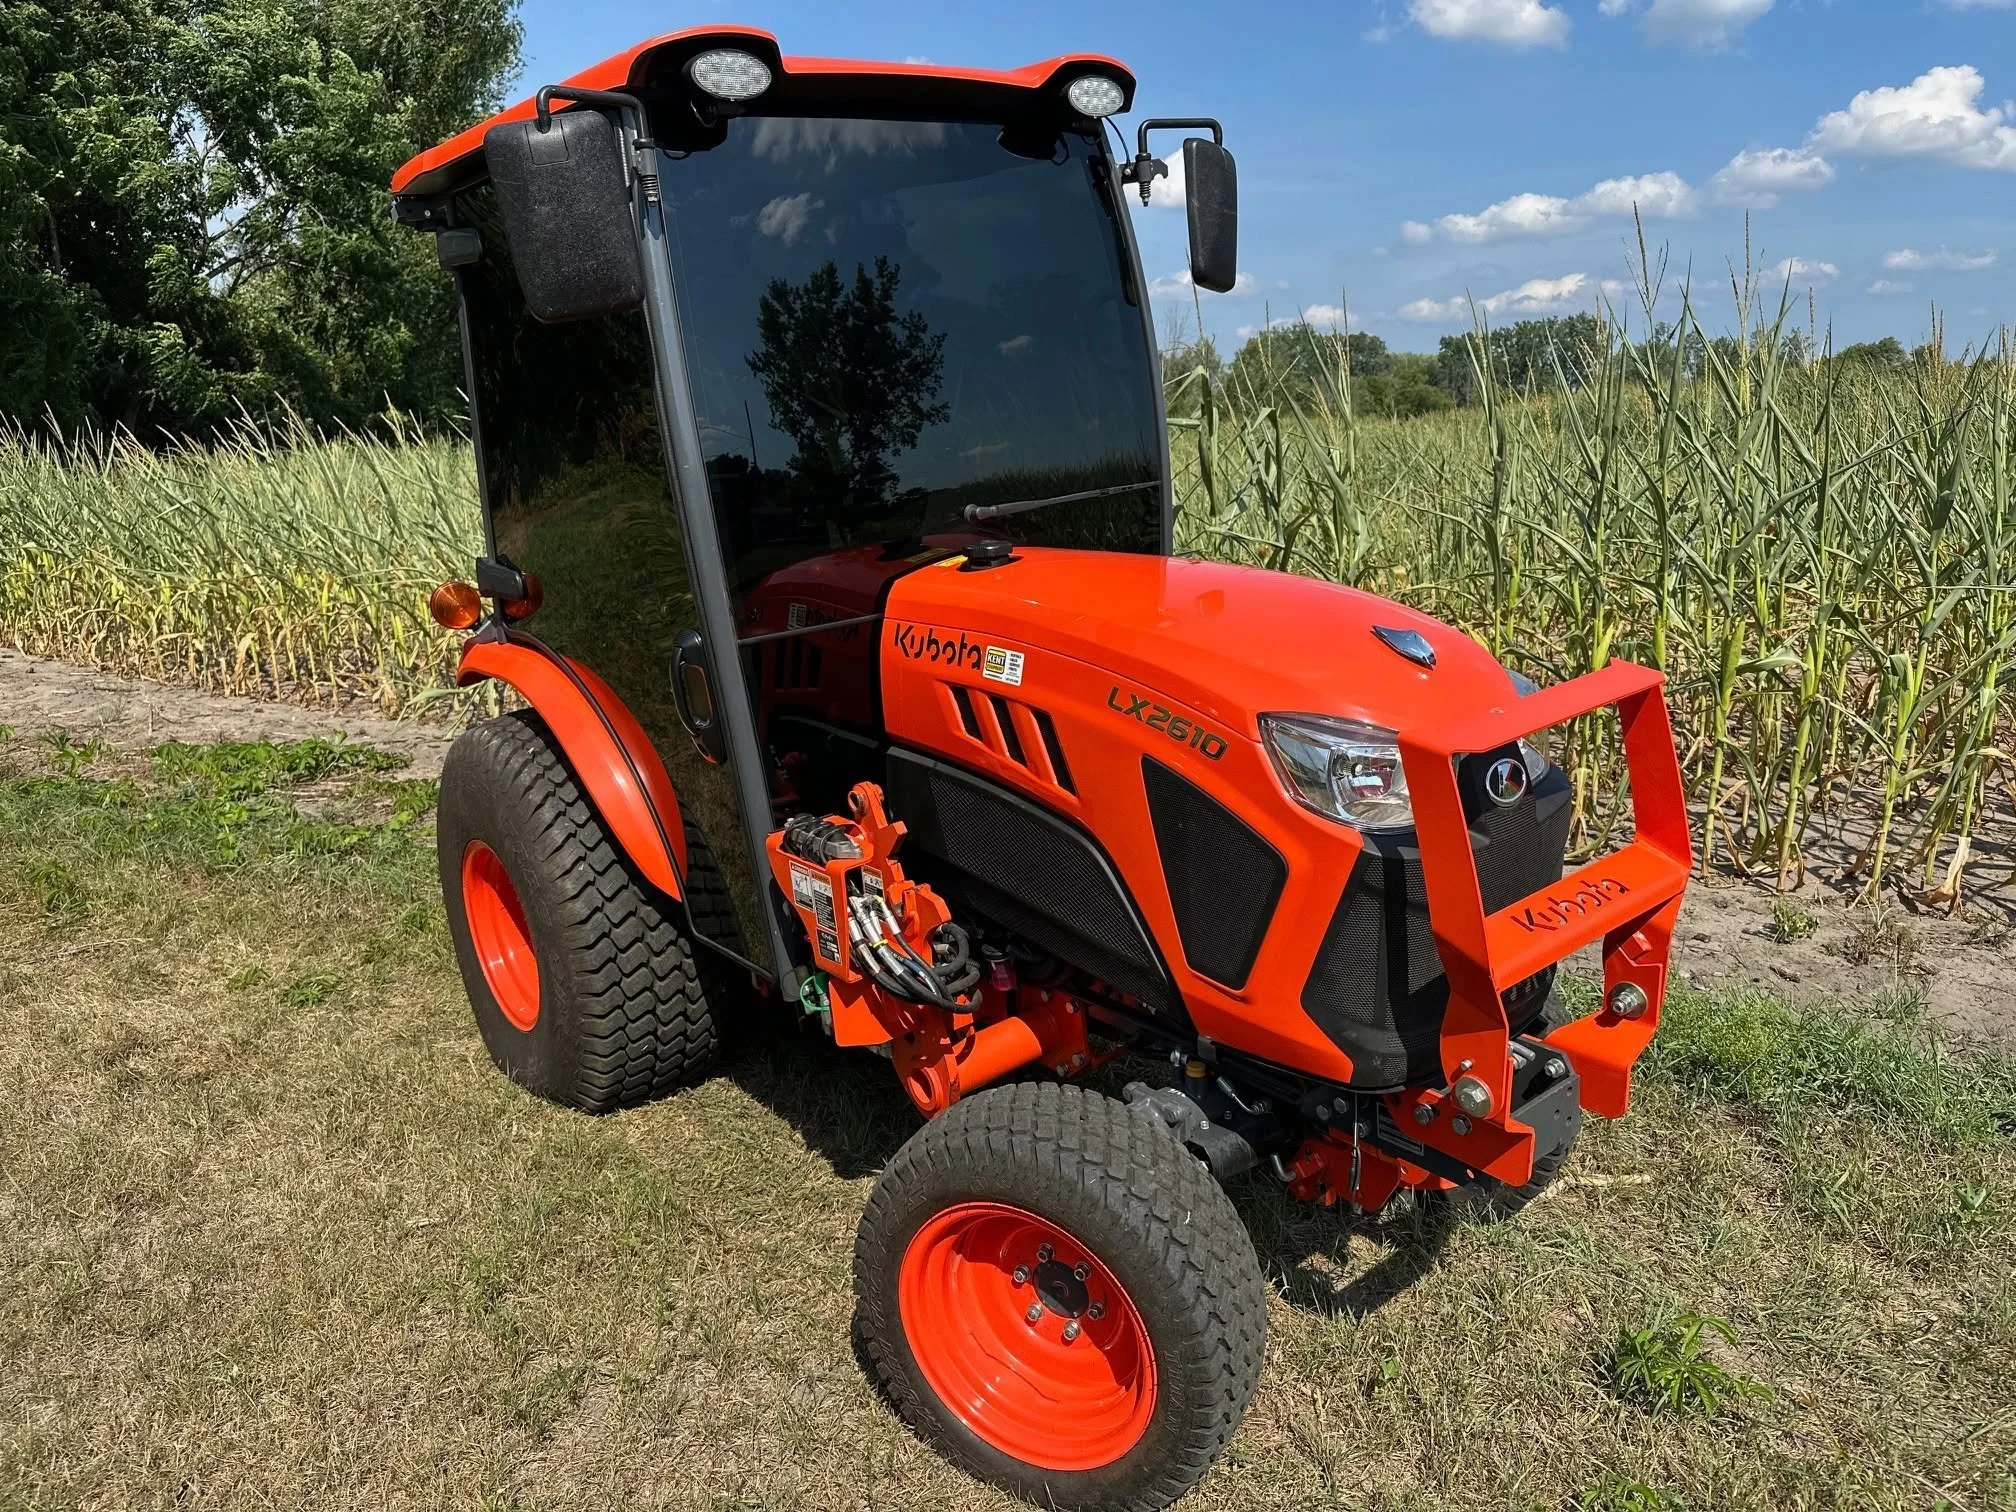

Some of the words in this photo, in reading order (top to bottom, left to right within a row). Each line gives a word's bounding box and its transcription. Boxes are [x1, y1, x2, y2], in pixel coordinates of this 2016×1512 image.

[894, 623, 982, 670] Kubota
[987, 653, 1005, 665] KENT
[1107, 686, 1228, 761] LX2610
[1510, 878, 1630, 932] Kubota
